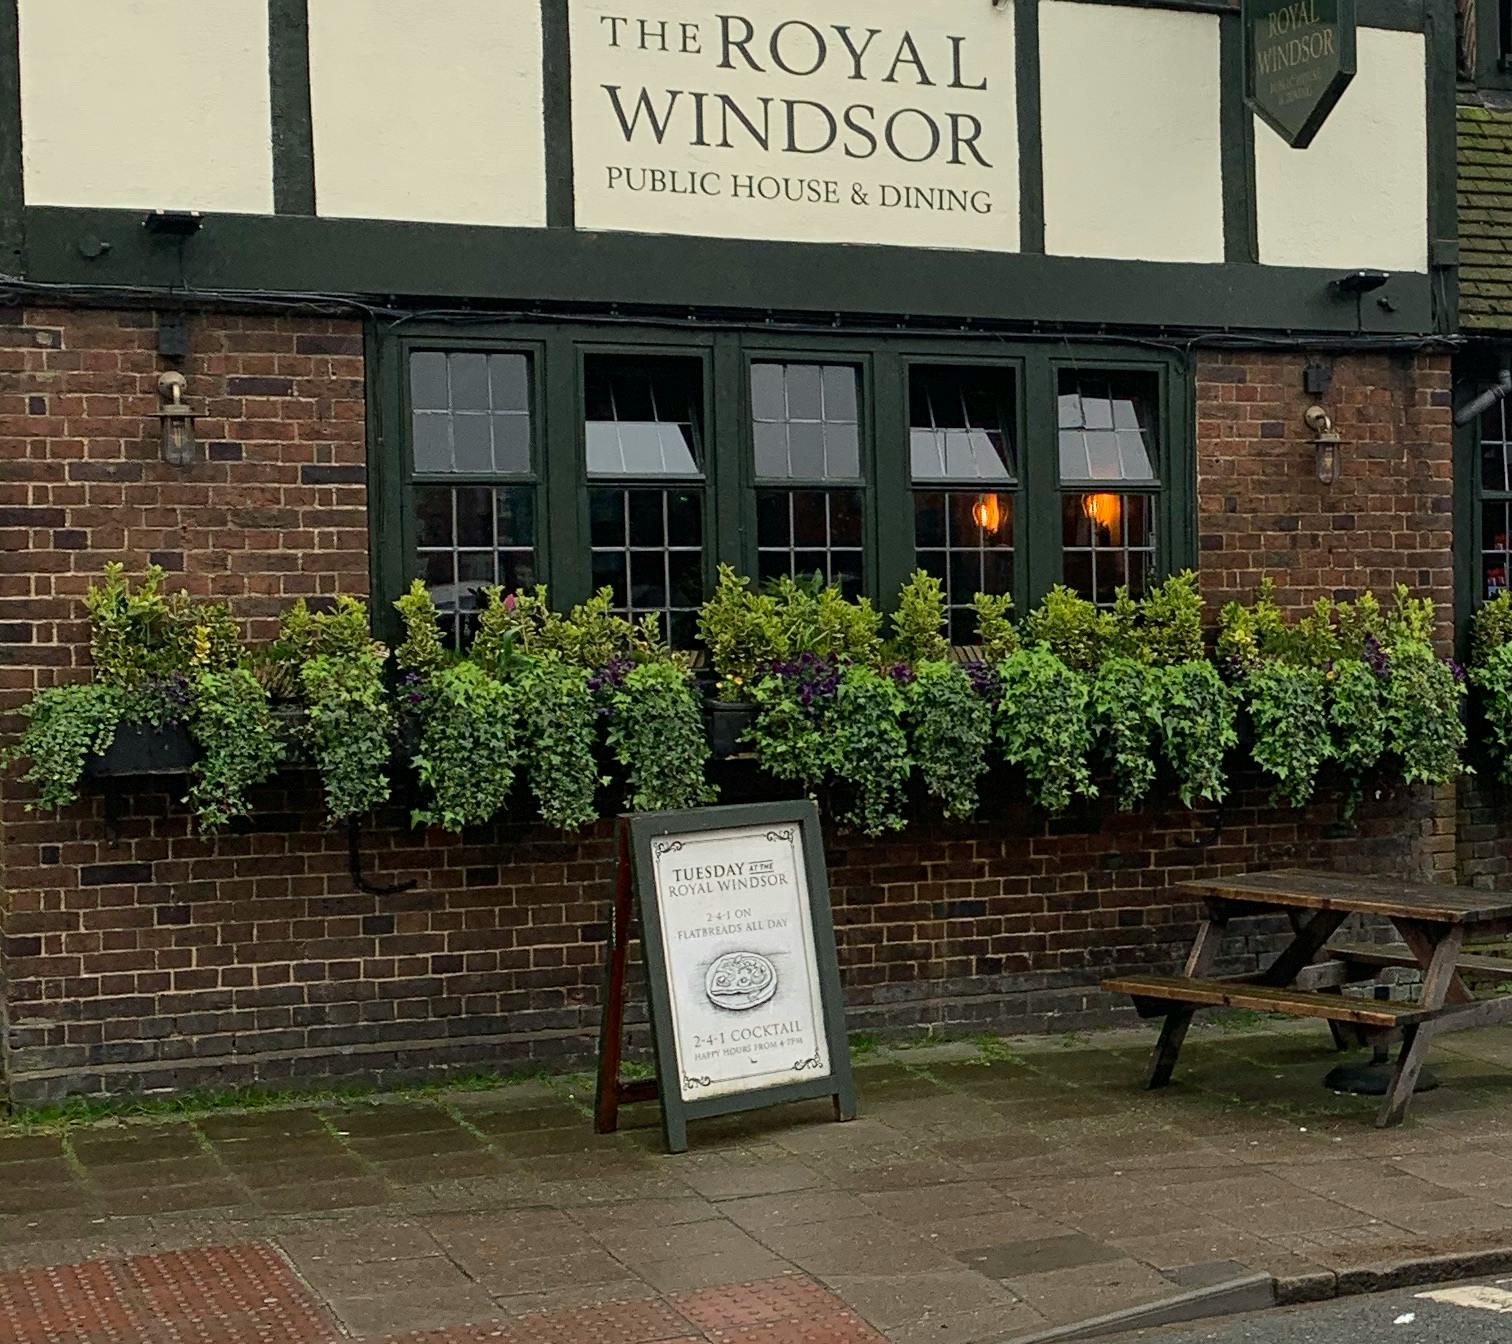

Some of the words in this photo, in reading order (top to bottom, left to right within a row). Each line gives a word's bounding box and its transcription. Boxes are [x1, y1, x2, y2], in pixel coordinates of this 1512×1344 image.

[600, 16, 702, 55] THE
[715, 14, 988, 92] ROYAL
[1257, 28, 1335, 75] WINDSOR
[600, 84, 994, 169] WINDSOR
[606, 166, 720, 196] PUBLIC
[731, 174, 840, 204] HOUSE
[851, 183, 870, 206] &
[879, 184, 993, 215] DINING
[669, 881, 713, 897] ROYAL
[717, 873, 788, 891] WINDSOR
[672, 862, 745, 882] TUESDAY
[749, 864, 758, 872] AT
[760, 862, 774, 870] THE
[734, 908, 752, 919] ON
[677, 923, 741, 940] FLATBREADS
[746, 919, 763, 932] ALL
[767, 918, 788, 929] DAY
[694, 1032, 725, 1048] 2-4-1
[731, 1020, 803, 1042] COCKTAIL
[694, 1048, 720, 1062] HAPPY
[754, 1041, 777, 1051] FROM
